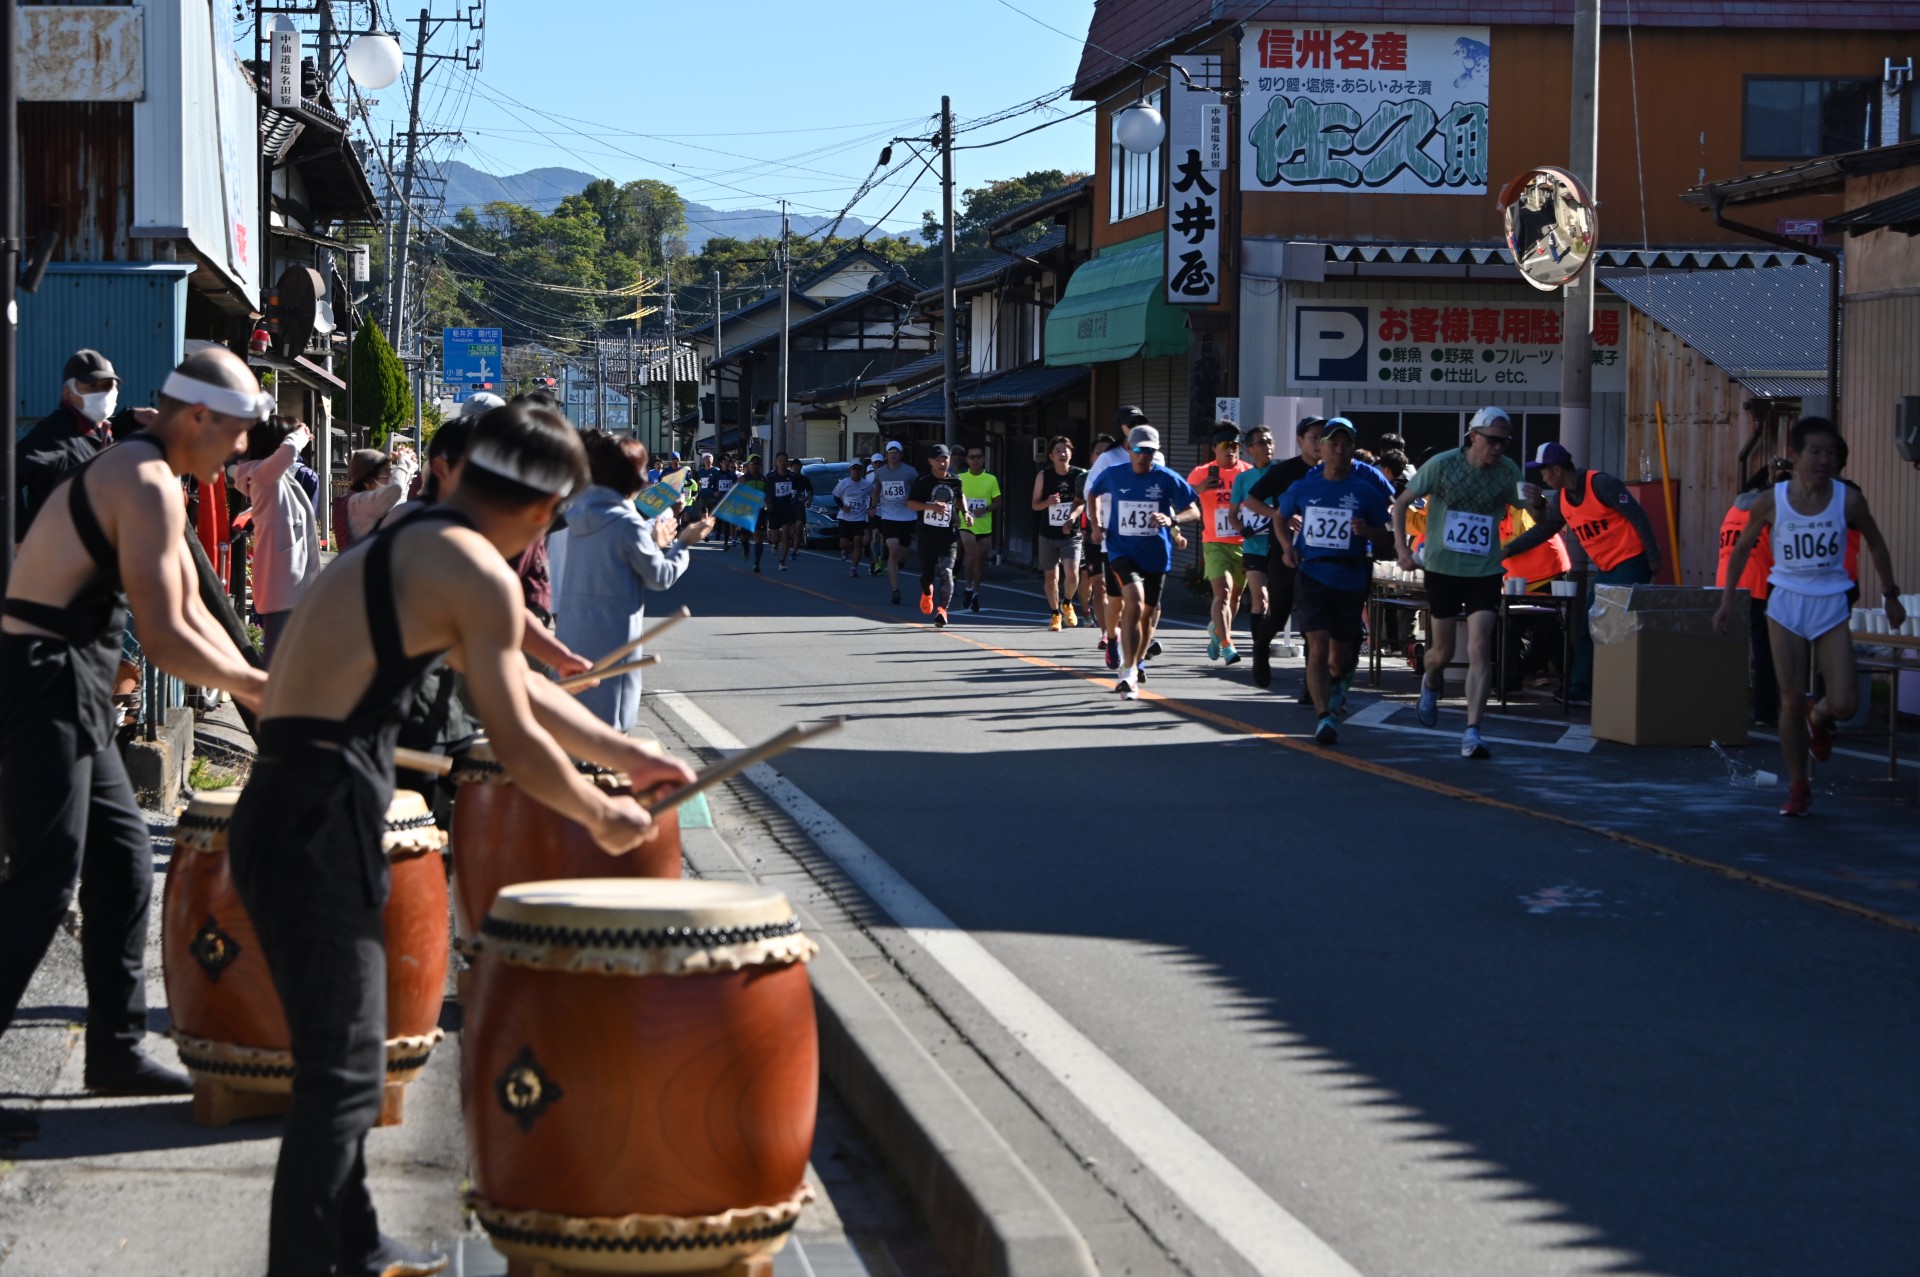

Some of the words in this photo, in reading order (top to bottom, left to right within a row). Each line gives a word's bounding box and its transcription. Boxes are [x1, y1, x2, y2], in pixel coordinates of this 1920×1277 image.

[1258, 29, 1408, 71] 信州名産
[281, 33, 291, 105] 中仙道塩名田宿
[1211, 107, 1221, 168] 中仙道塩名田宿
[1171, 148, 1217, 296] 大井屋
[1378, 307, 1620, 346] お客様専用駐場
[1299, 310, 1364, 376] P
[1392, 347, 1422, 364] 鮮魚
[1444, 348, 1474, 364] 野菜
[1496, 349, 1553, 365] フルーツ
[1392, 366, 1422, 383] 雑貨
[1444, 367, 1487, 384] 仕出し
[1495, 369, 1528, 384] etc.
[884, 485, 904, 496] A638
[1306, 518, 1349, 540] A326
[1446, 522, 1490, 547] A269
[1572, 519, 1609, 541] TAFF
[1783, 531, 1839, 560] B1066
